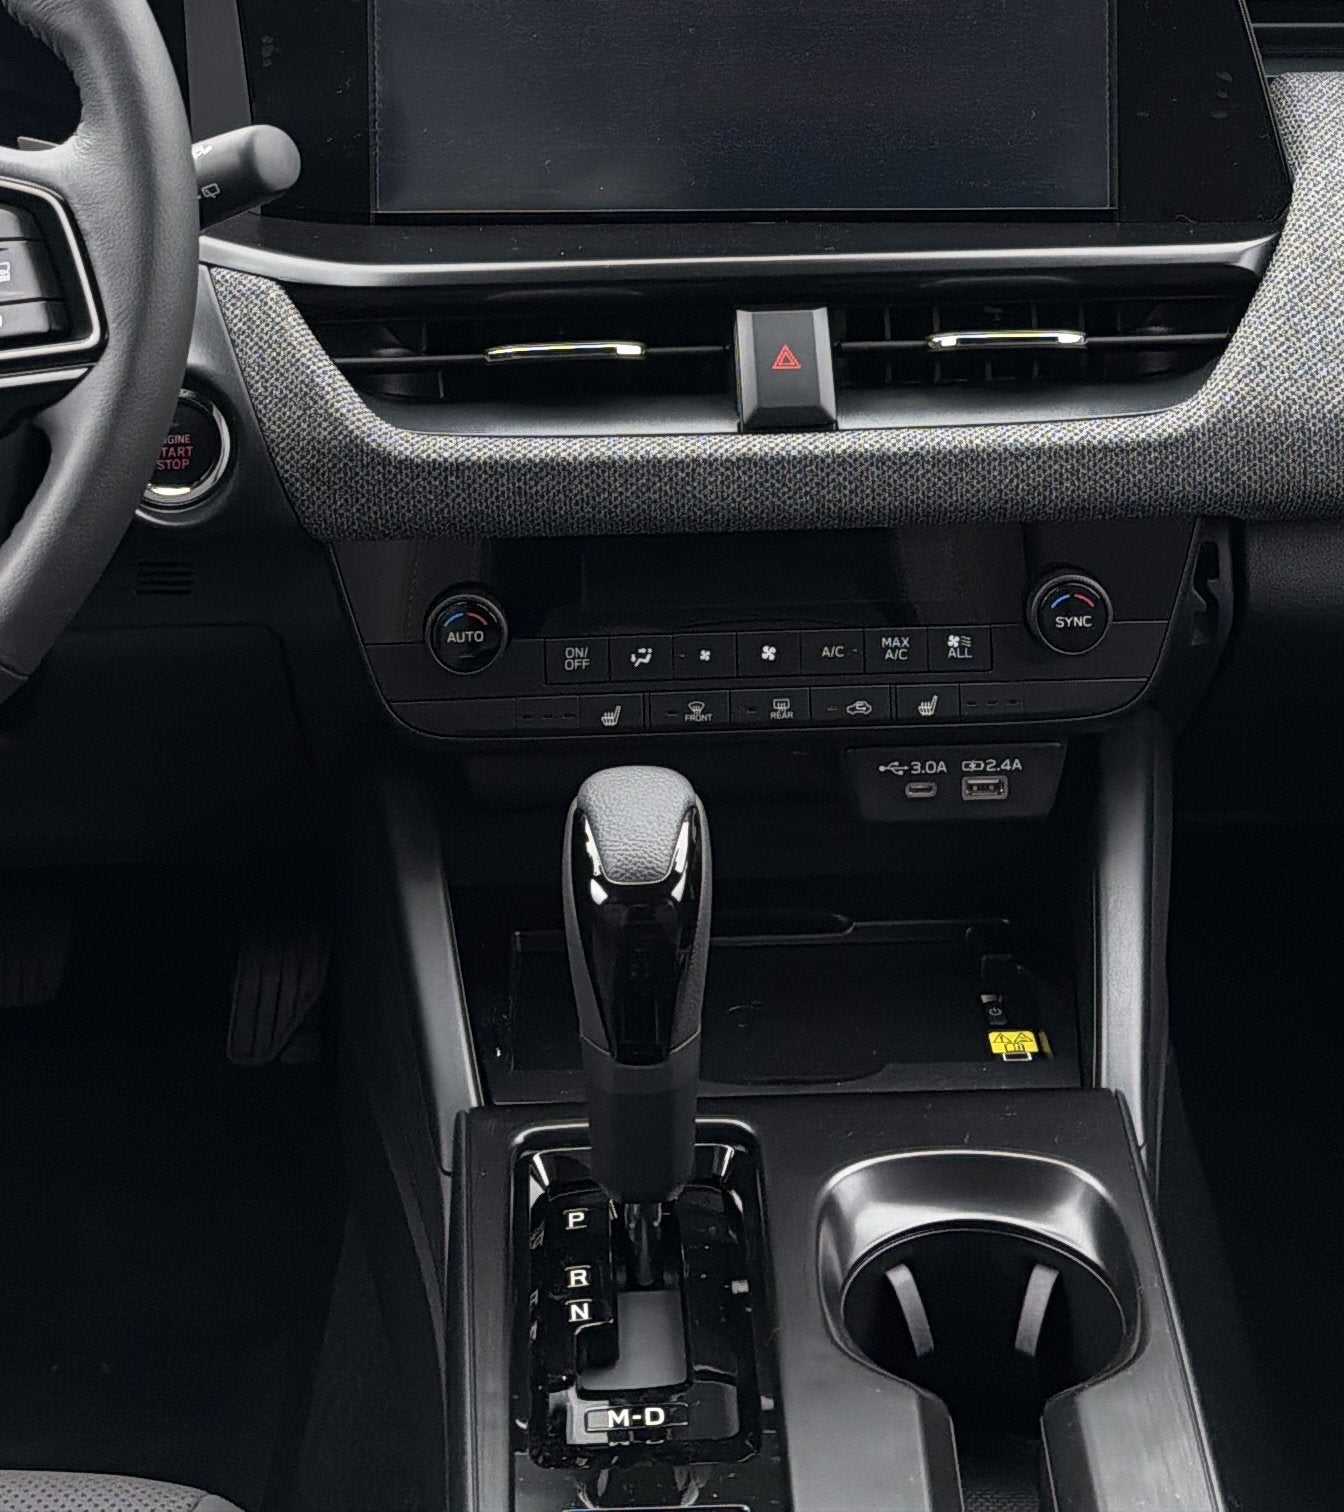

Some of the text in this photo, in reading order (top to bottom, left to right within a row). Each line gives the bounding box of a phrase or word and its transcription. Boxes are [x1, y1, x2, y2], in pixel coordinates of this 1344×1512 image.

[164, 433, 192, 444] GINE
[160, 445, 194, 458] TART
[156, 458, 190, 470] STOP
[1055, 615, 1092, 629] SYNC
[446, 630, 484, 643] AUTO
[881, 636, 910, 649] MAX
[564, 646, 589, 658] ON/
[821, 645, 845, 659] A/C
[885, 648, 908, 661] A/C
[947, 646, 973, 659] ALL
[563, 658, 590, 671] OFF
[683, 713, 713, 723] FRONT
[770, 710, 794, 720] REAR
[911, 758, 1023, 775] 3.0A 2.4A
[568, 1211, 585, 1228] P
[569, 1269, 588, 1287] R
[570, 1303, 589, 1321] N
[607, 1406, 666, 1429] M-D
